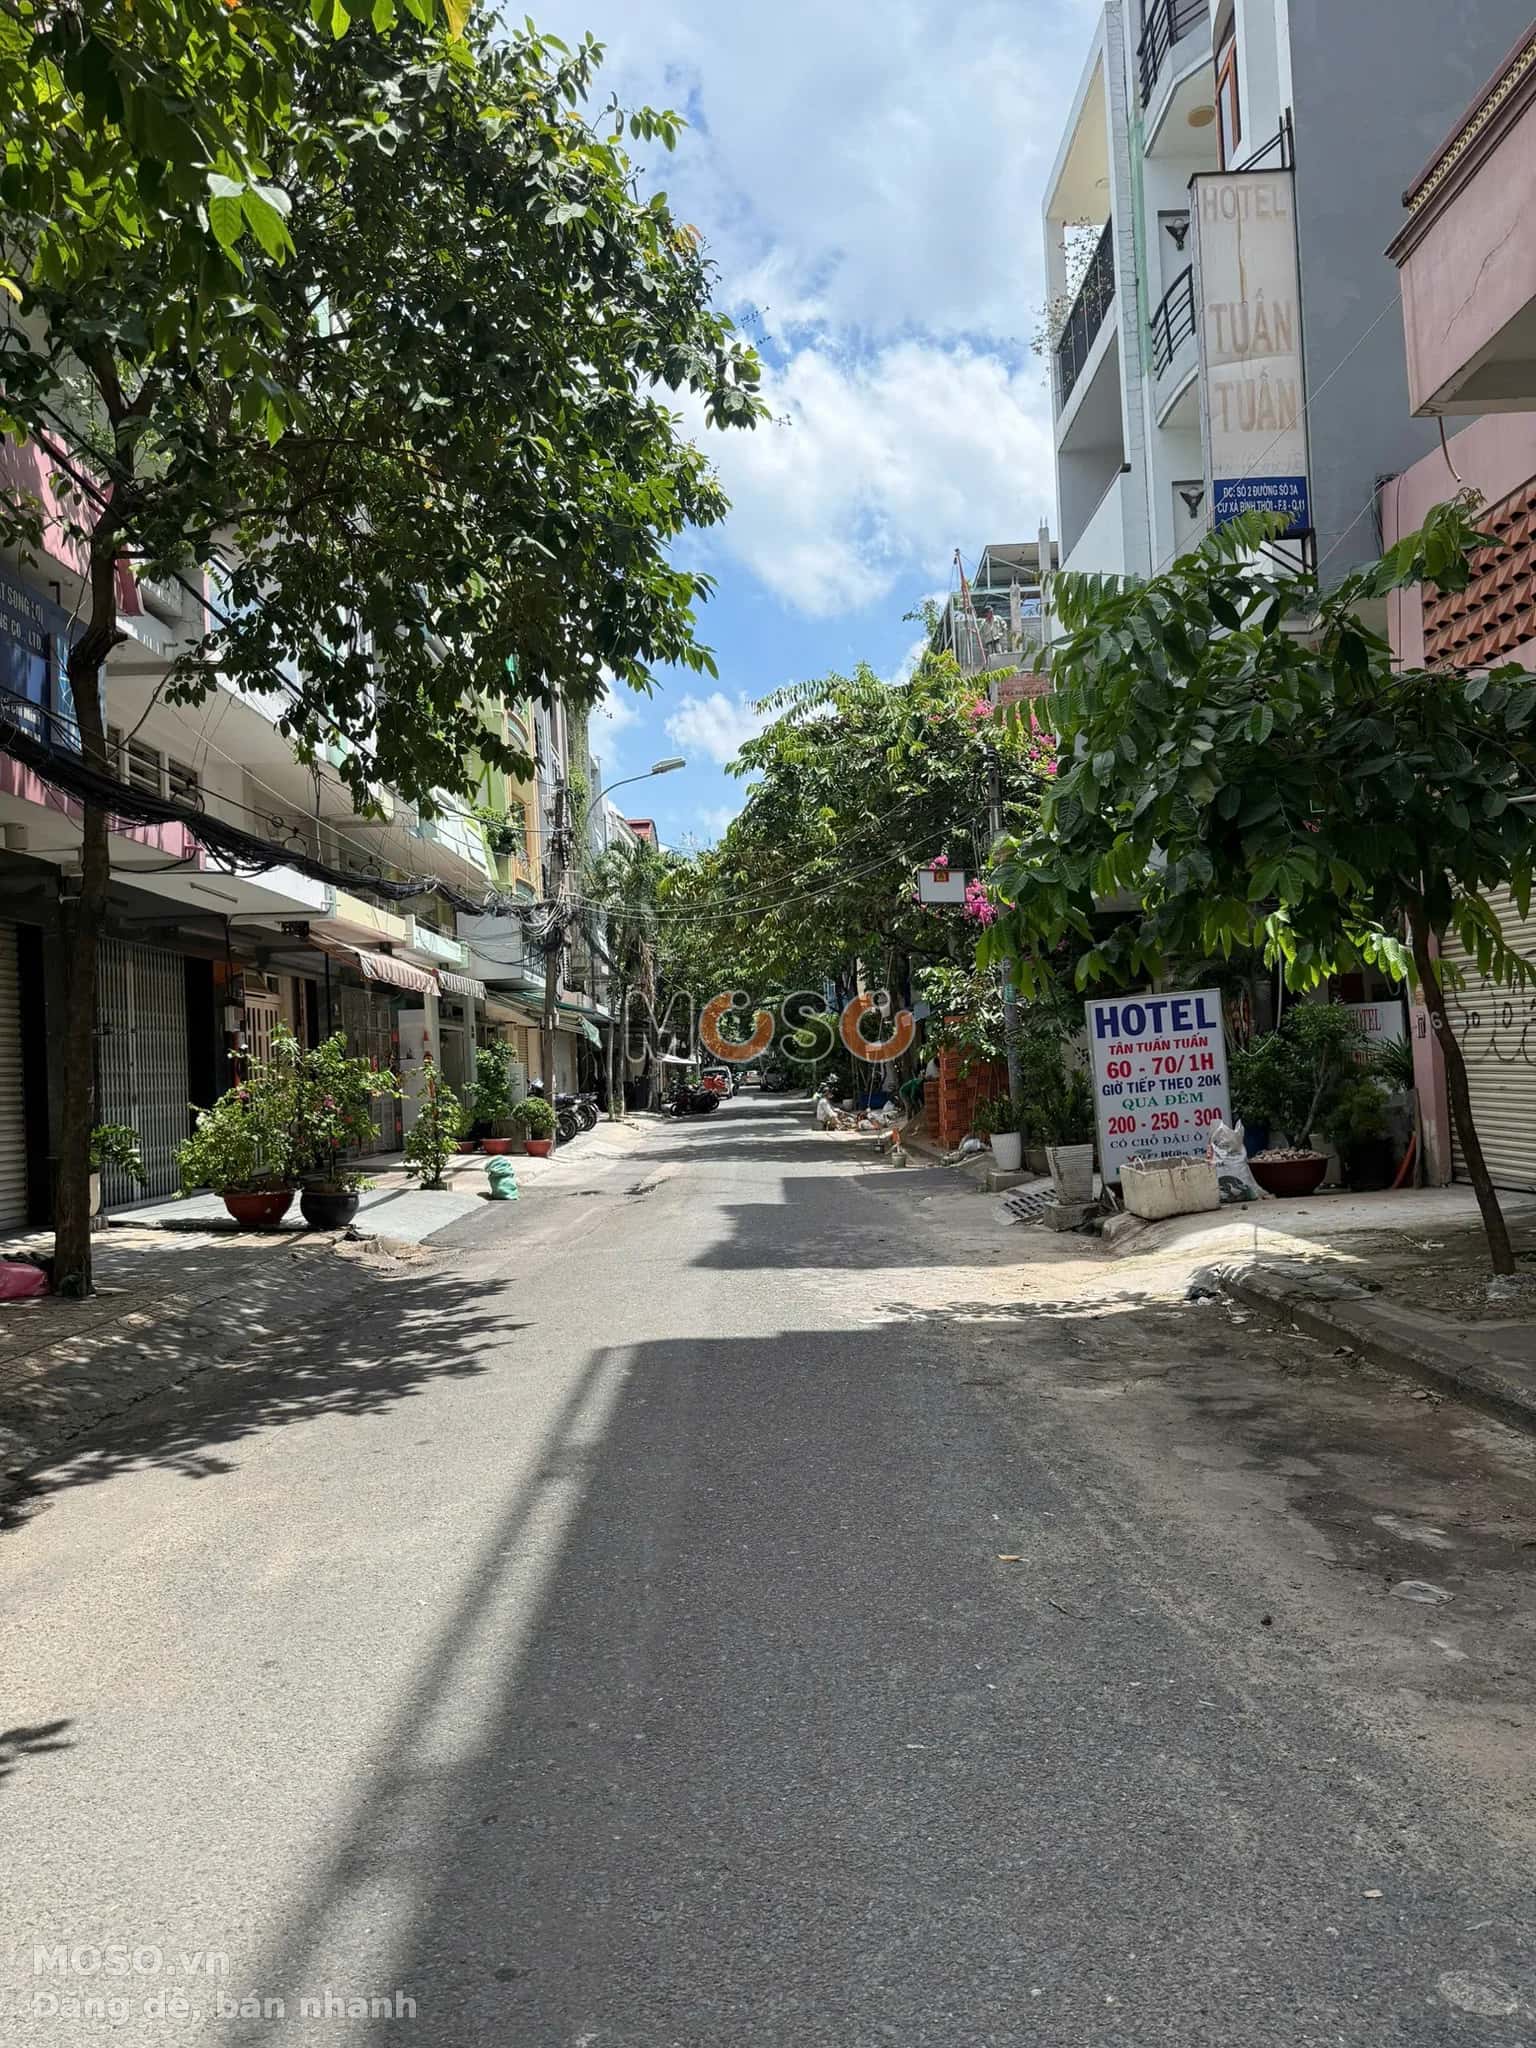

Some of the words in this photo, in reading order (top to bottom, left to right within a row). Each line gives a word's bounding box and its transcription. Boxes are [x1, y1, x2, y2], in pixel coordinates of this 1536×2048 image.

[1202, 184, 1287, 222] HOTEL
[1247, 486, 1252, 497] 2
[1095, 998, 1217, 1038] HOTEL
[1108, 1041, 1133, 1055] TÂN
[1136, 1035, 1171, 1053] TUẤN
[1173, 1032, 1208, 1049] TUẤN
[1106, 1060, 1132, 1079] 60
[1102, 1079, 1123, 1096] GIỜ
[1126, 1076, 1156, 1094] TIẾP
[1159, 1077, 1194, 1091] THEO
[1197, 1074, 1222, 1088] 20K
[1108, 1115, 1136, 1135] 200
[1151, 1111, 1179, 1130] 250
